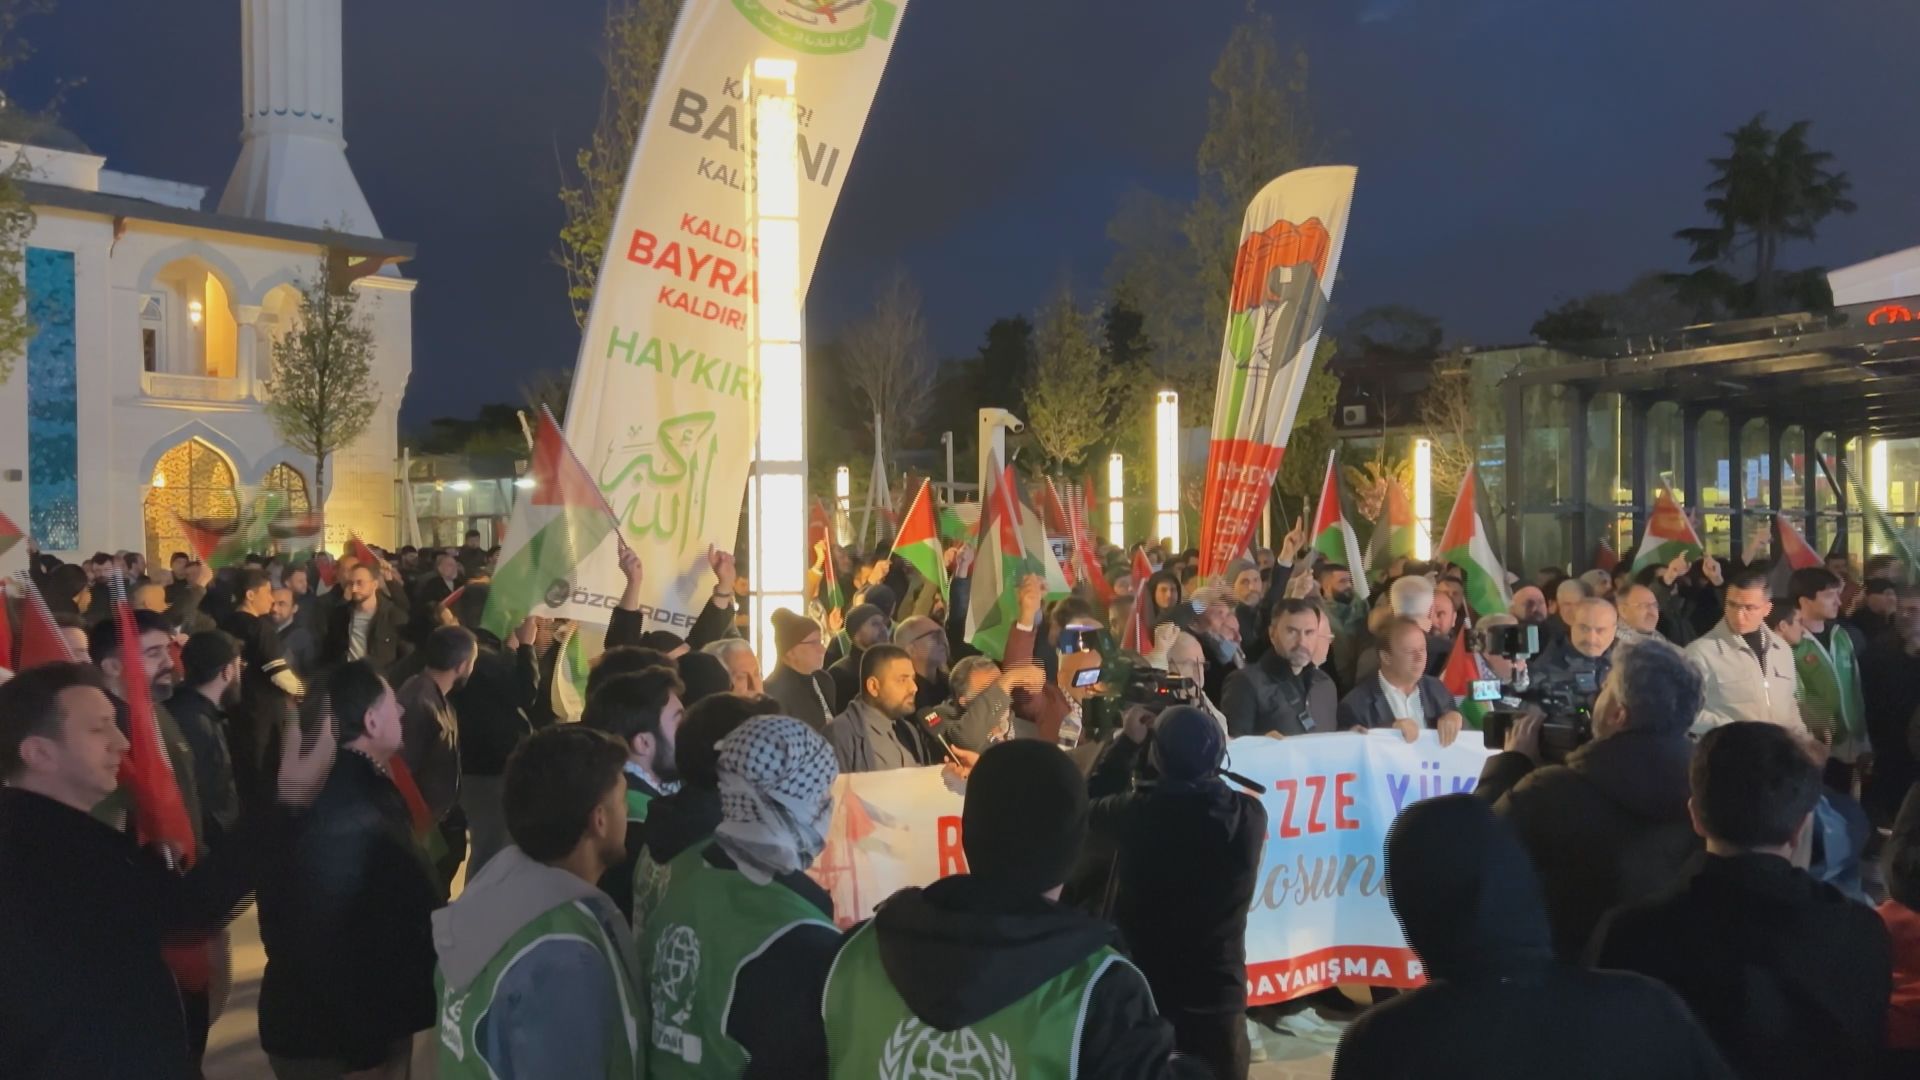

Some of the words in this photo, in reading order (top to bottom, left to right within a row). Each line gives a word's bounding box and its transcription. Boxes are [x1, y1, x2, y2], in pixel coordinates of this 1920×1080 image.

[669, 88, 840, 187] BANI
[627, 229, 758, 304] BAYRA
[657, 285, 748, 331] KALDIR!
[572, 586, 699, 628] ÖZGRDER
[1263, 772, 1360, 841] ZZE
[1407, 960, 1424, 980] P
